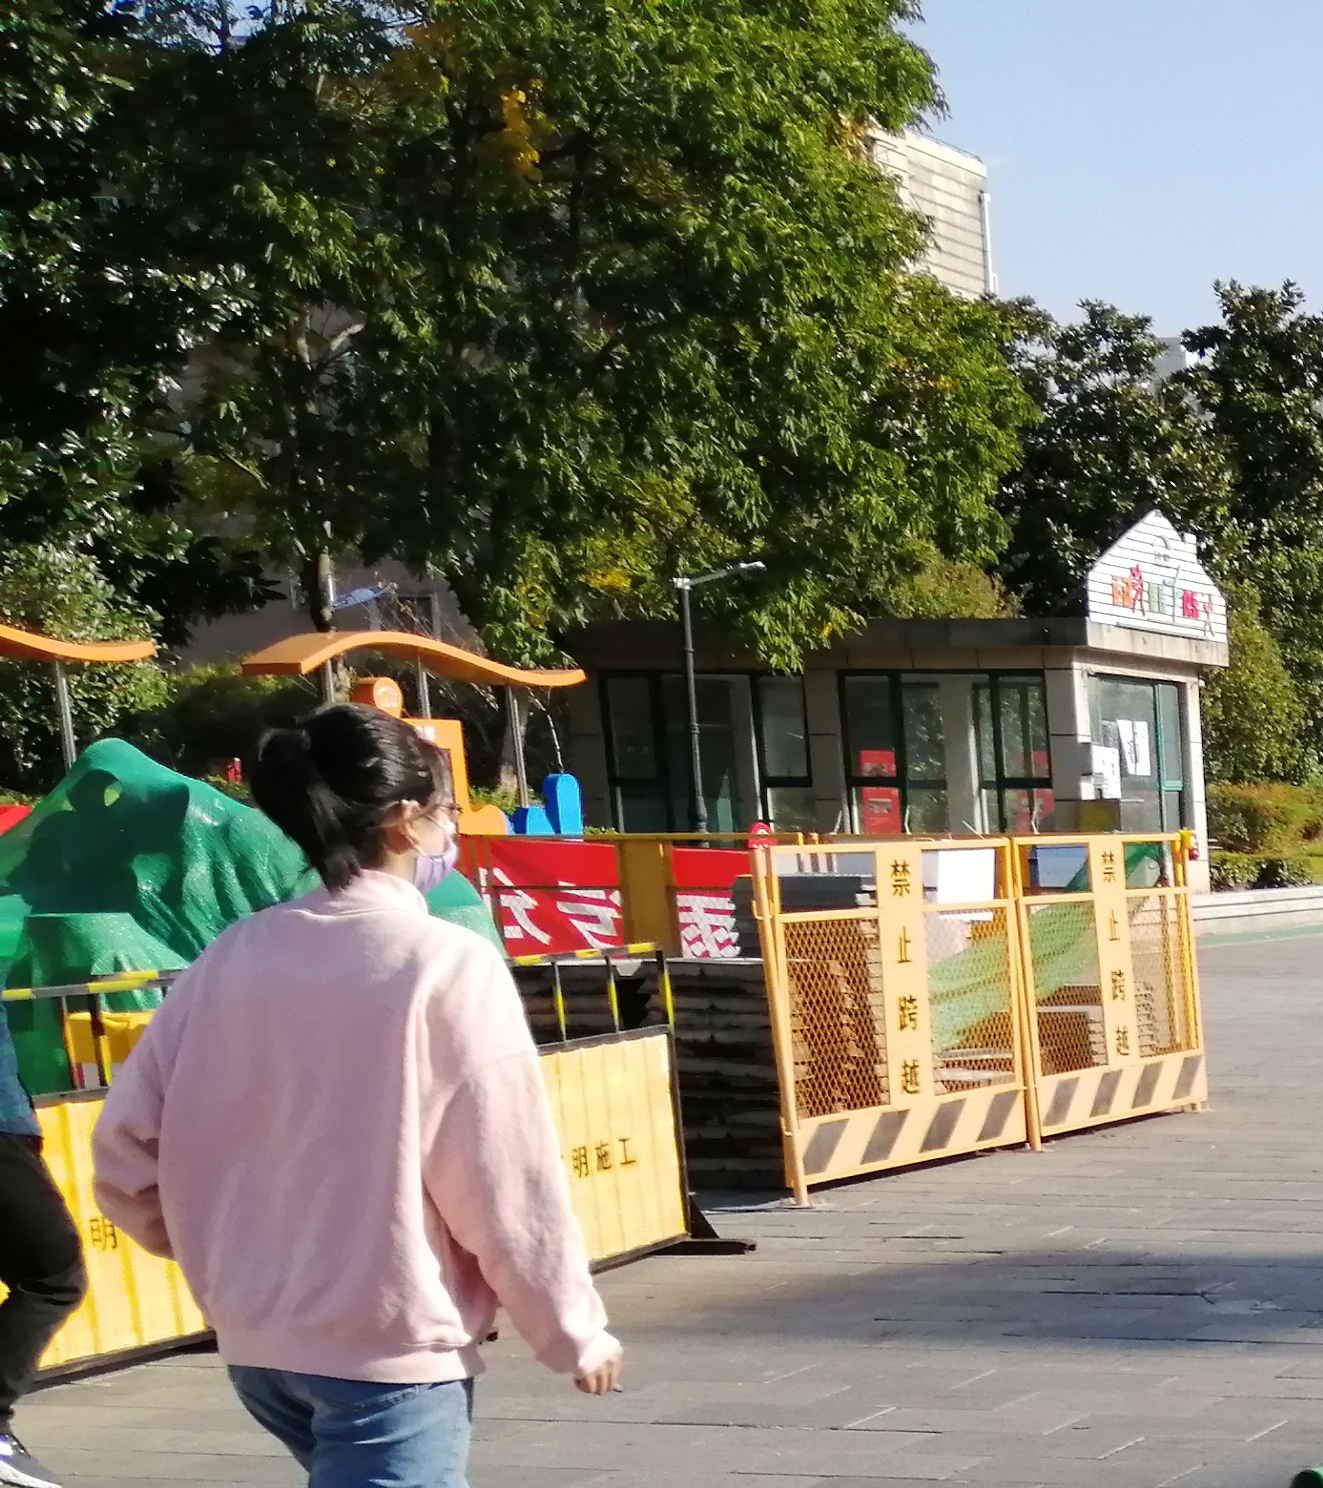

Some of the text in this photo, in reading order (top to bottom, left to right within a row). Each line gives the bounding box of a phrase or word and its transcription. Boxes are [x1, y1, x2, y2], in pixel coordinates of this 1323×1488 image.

[890, 859, 921, 1095] 禁止跨越
[1101, 850, 1129, 1057] 禁止跨越
[561, 1137, 637, 1179] 明施工
